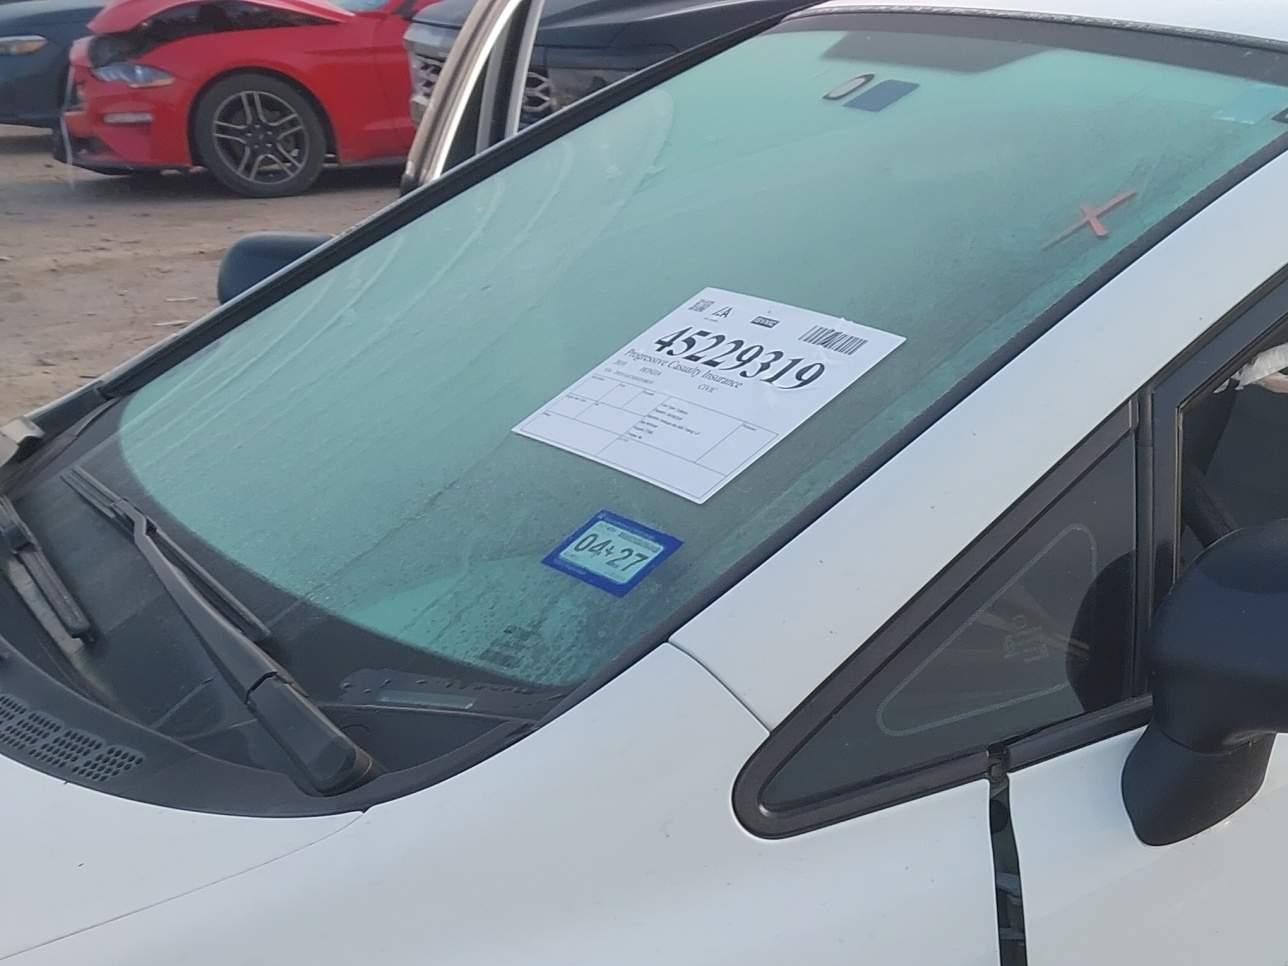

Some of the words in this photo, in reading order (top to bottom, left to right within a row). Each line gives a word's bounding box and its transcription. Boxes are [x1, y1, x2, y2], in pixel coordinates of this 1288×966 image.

[625, 348, 668, 369] Progressive
[667, 360, 702, 378] Casualty
[702, 370, 744, 389] Insurance
[654, 326, 826, 391] 45229319
